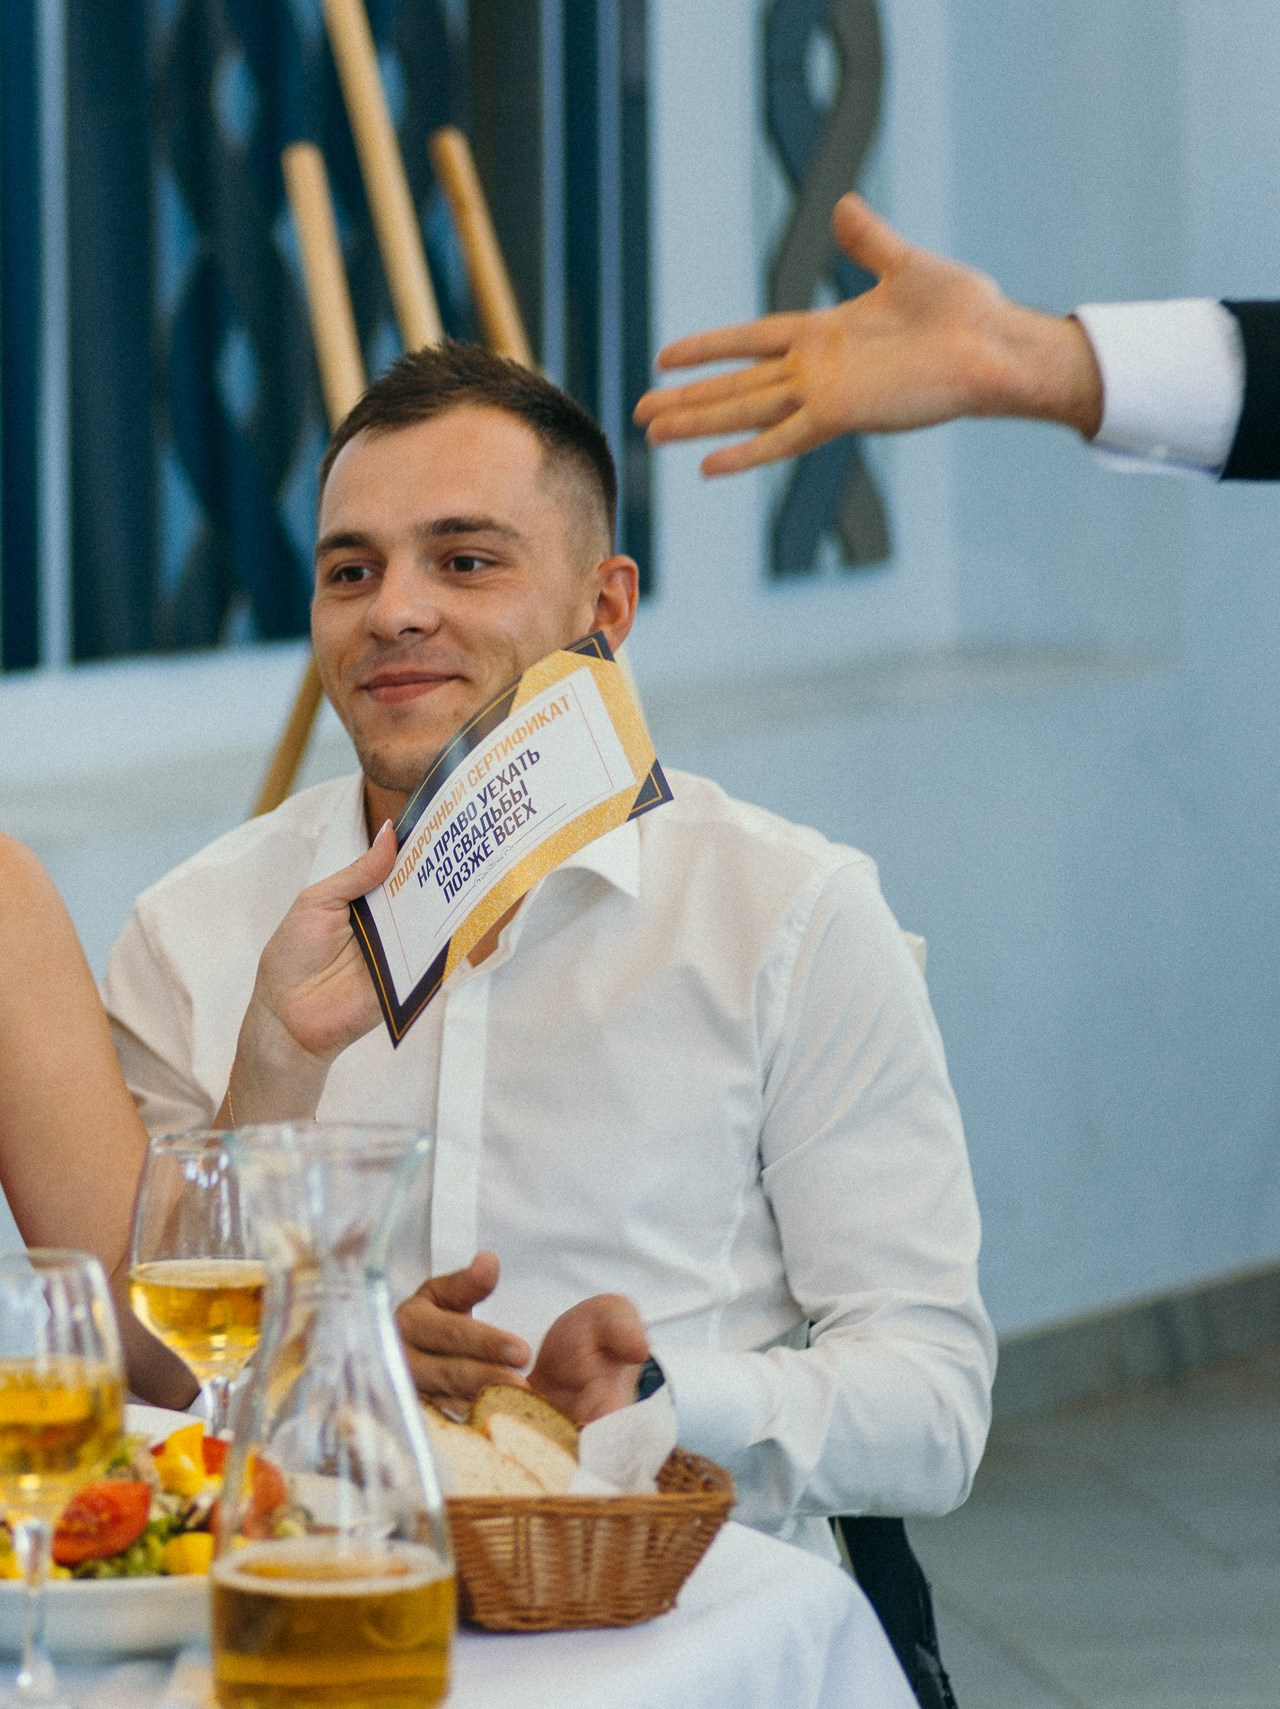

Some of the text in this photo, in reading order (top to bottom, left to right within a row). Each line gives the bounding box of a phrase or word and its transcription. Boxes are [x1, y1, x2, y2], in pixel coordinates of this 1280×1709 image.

[388, 695, 570, 898] ПОДАРОЧНЫЙ СЕРТИФИКАТ
[417, 749, 540, 888] НА ПРАВО УЕХАТЬ
[435, 779, 529, 887] СО СВАДЬБЫ
[443, 797, 537, 904] ПОЗЖЕ ВСЕХ
